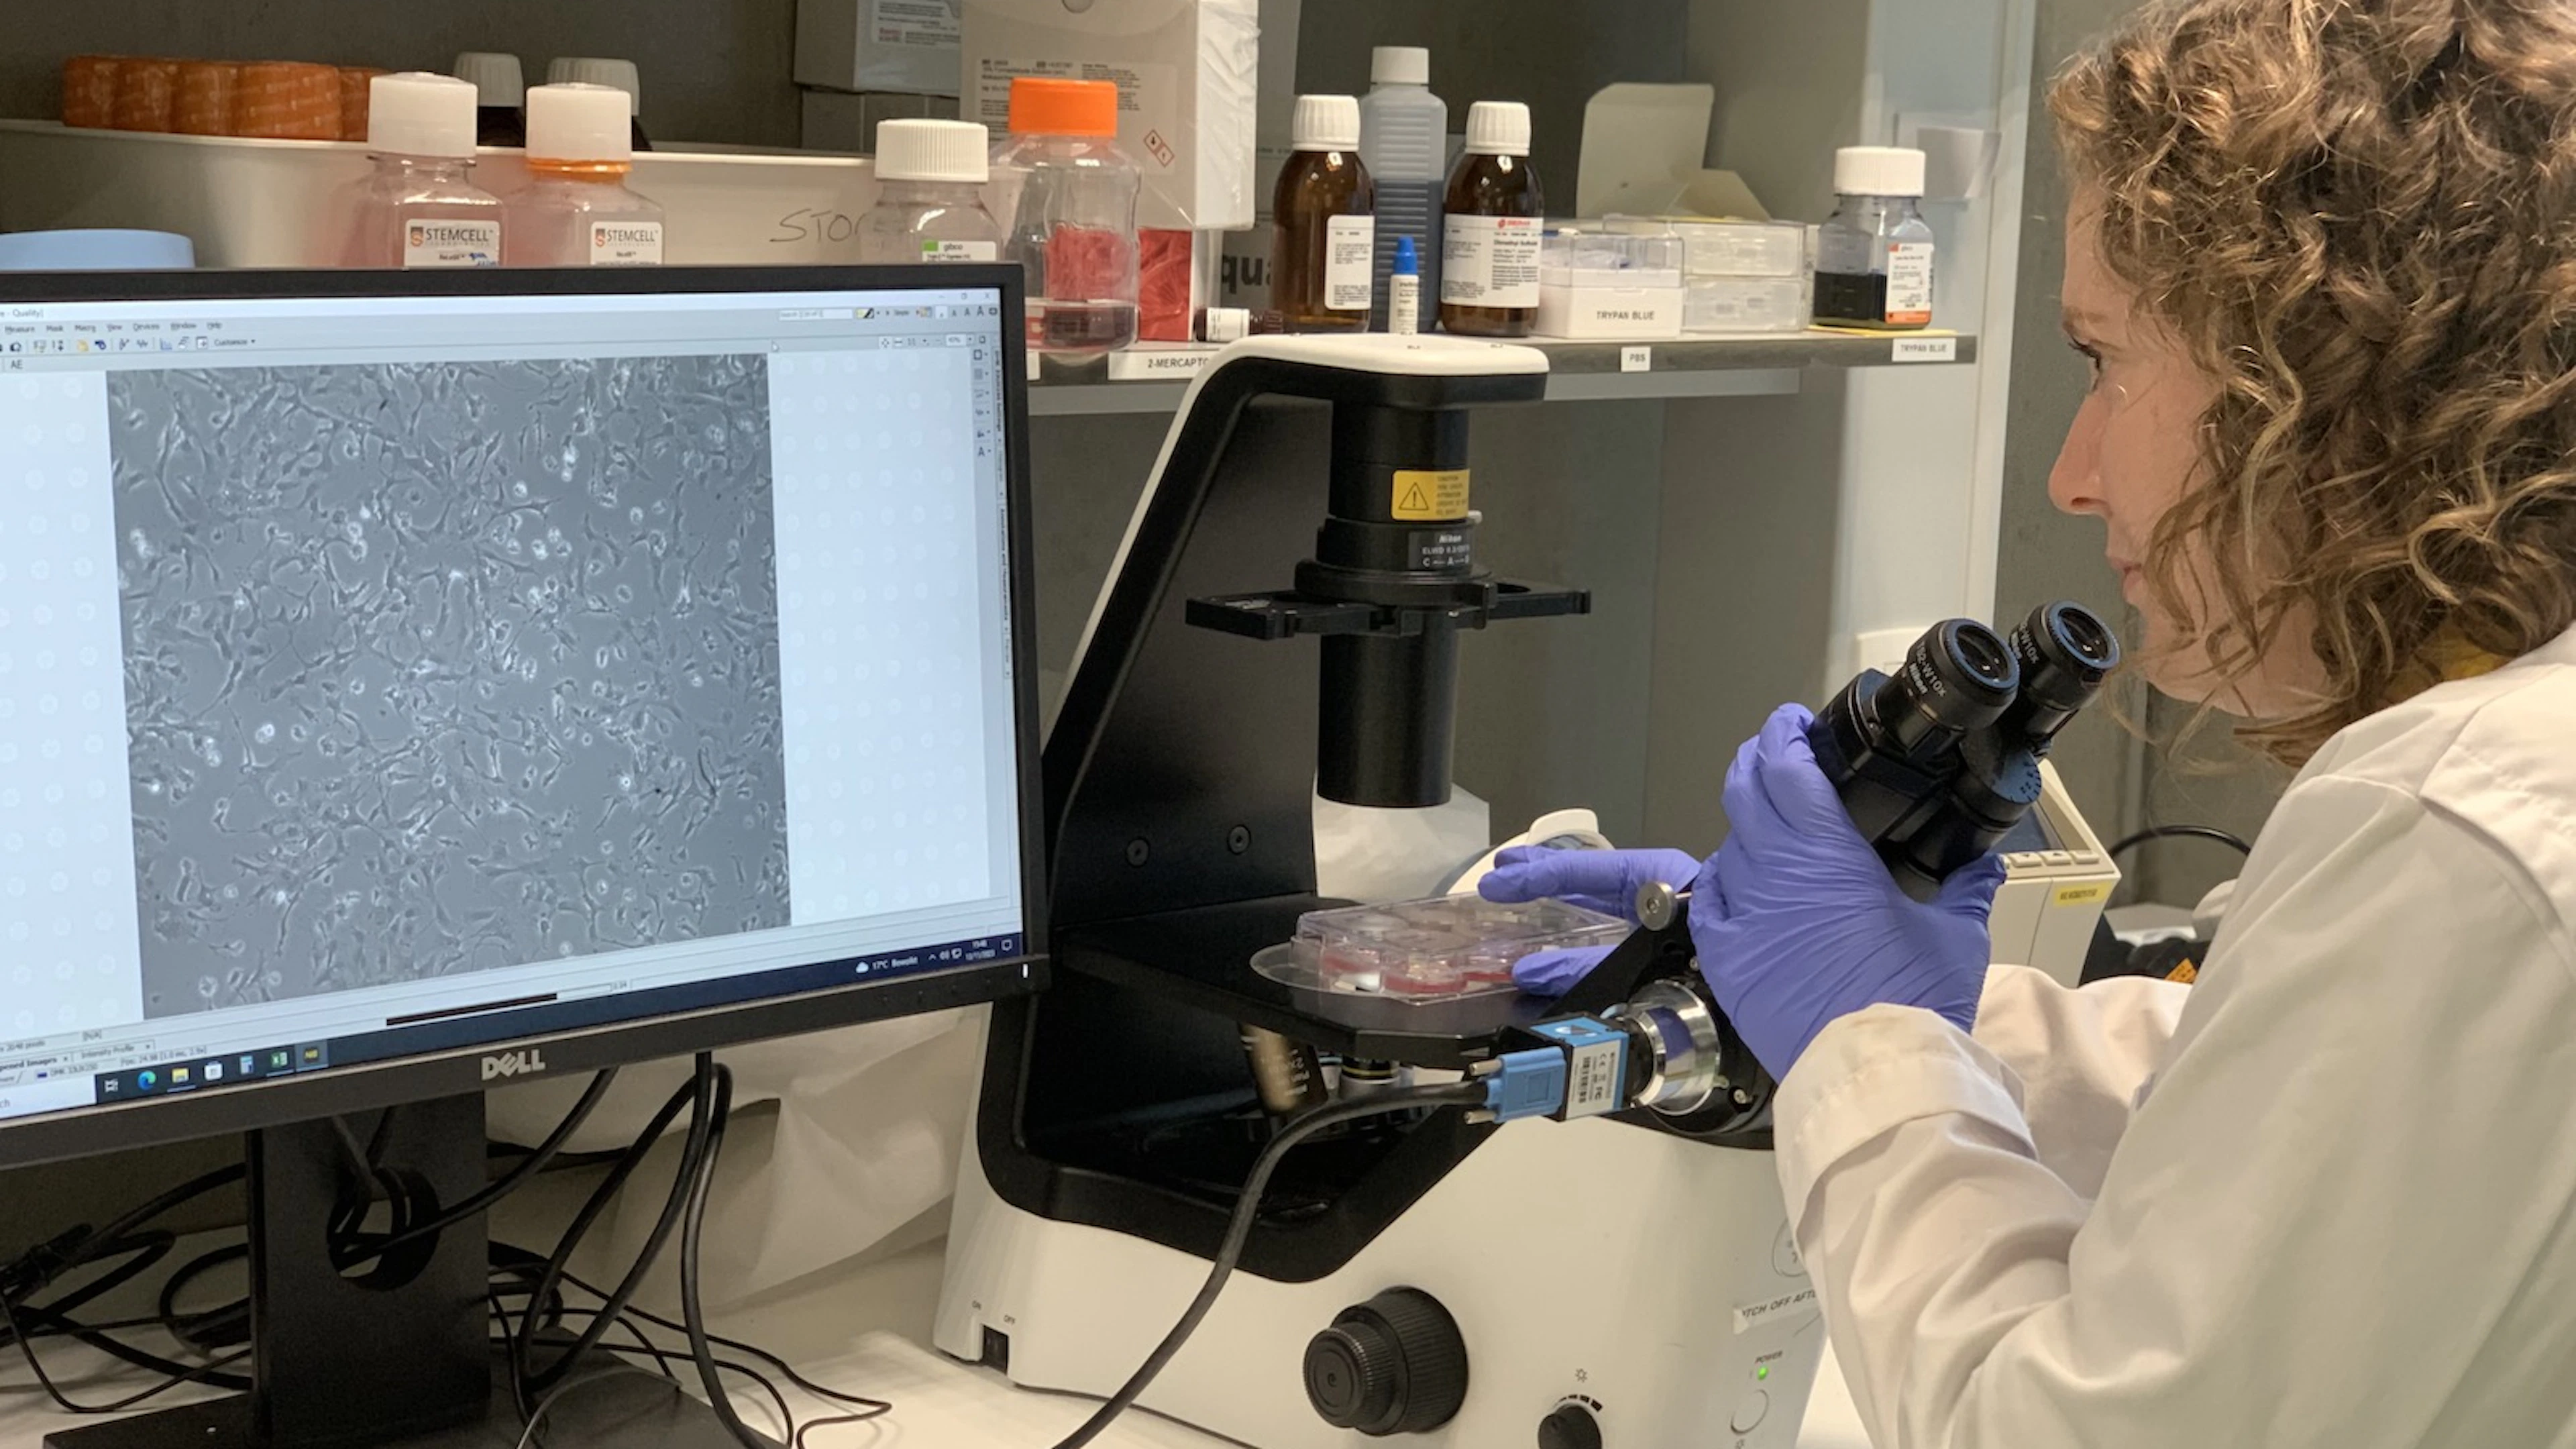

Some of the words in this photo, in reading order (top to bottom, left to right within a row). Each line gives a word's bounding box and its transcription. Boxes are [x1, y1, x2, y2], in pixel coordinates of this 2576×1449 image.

[1222, 255, 1271, 294] qu
[1597, 311, 1629, 319] TRYPAN
[1632, 311, 1654, 320] BLUE
[1900, 344, 1927, 352] TRYPAN
[1929, 343, 1947, 352] BLUE
[1629, 353, 1646, 363] PBS
[482, 1049, 545, 1081] DELL
[971, 1300, 982, 1311] ON
[1770, 1295, 1792, 1311] OFF
[1003, 1314, 1016, 1326] OFF
[1754, 1349, 1784, 1364] POWER
